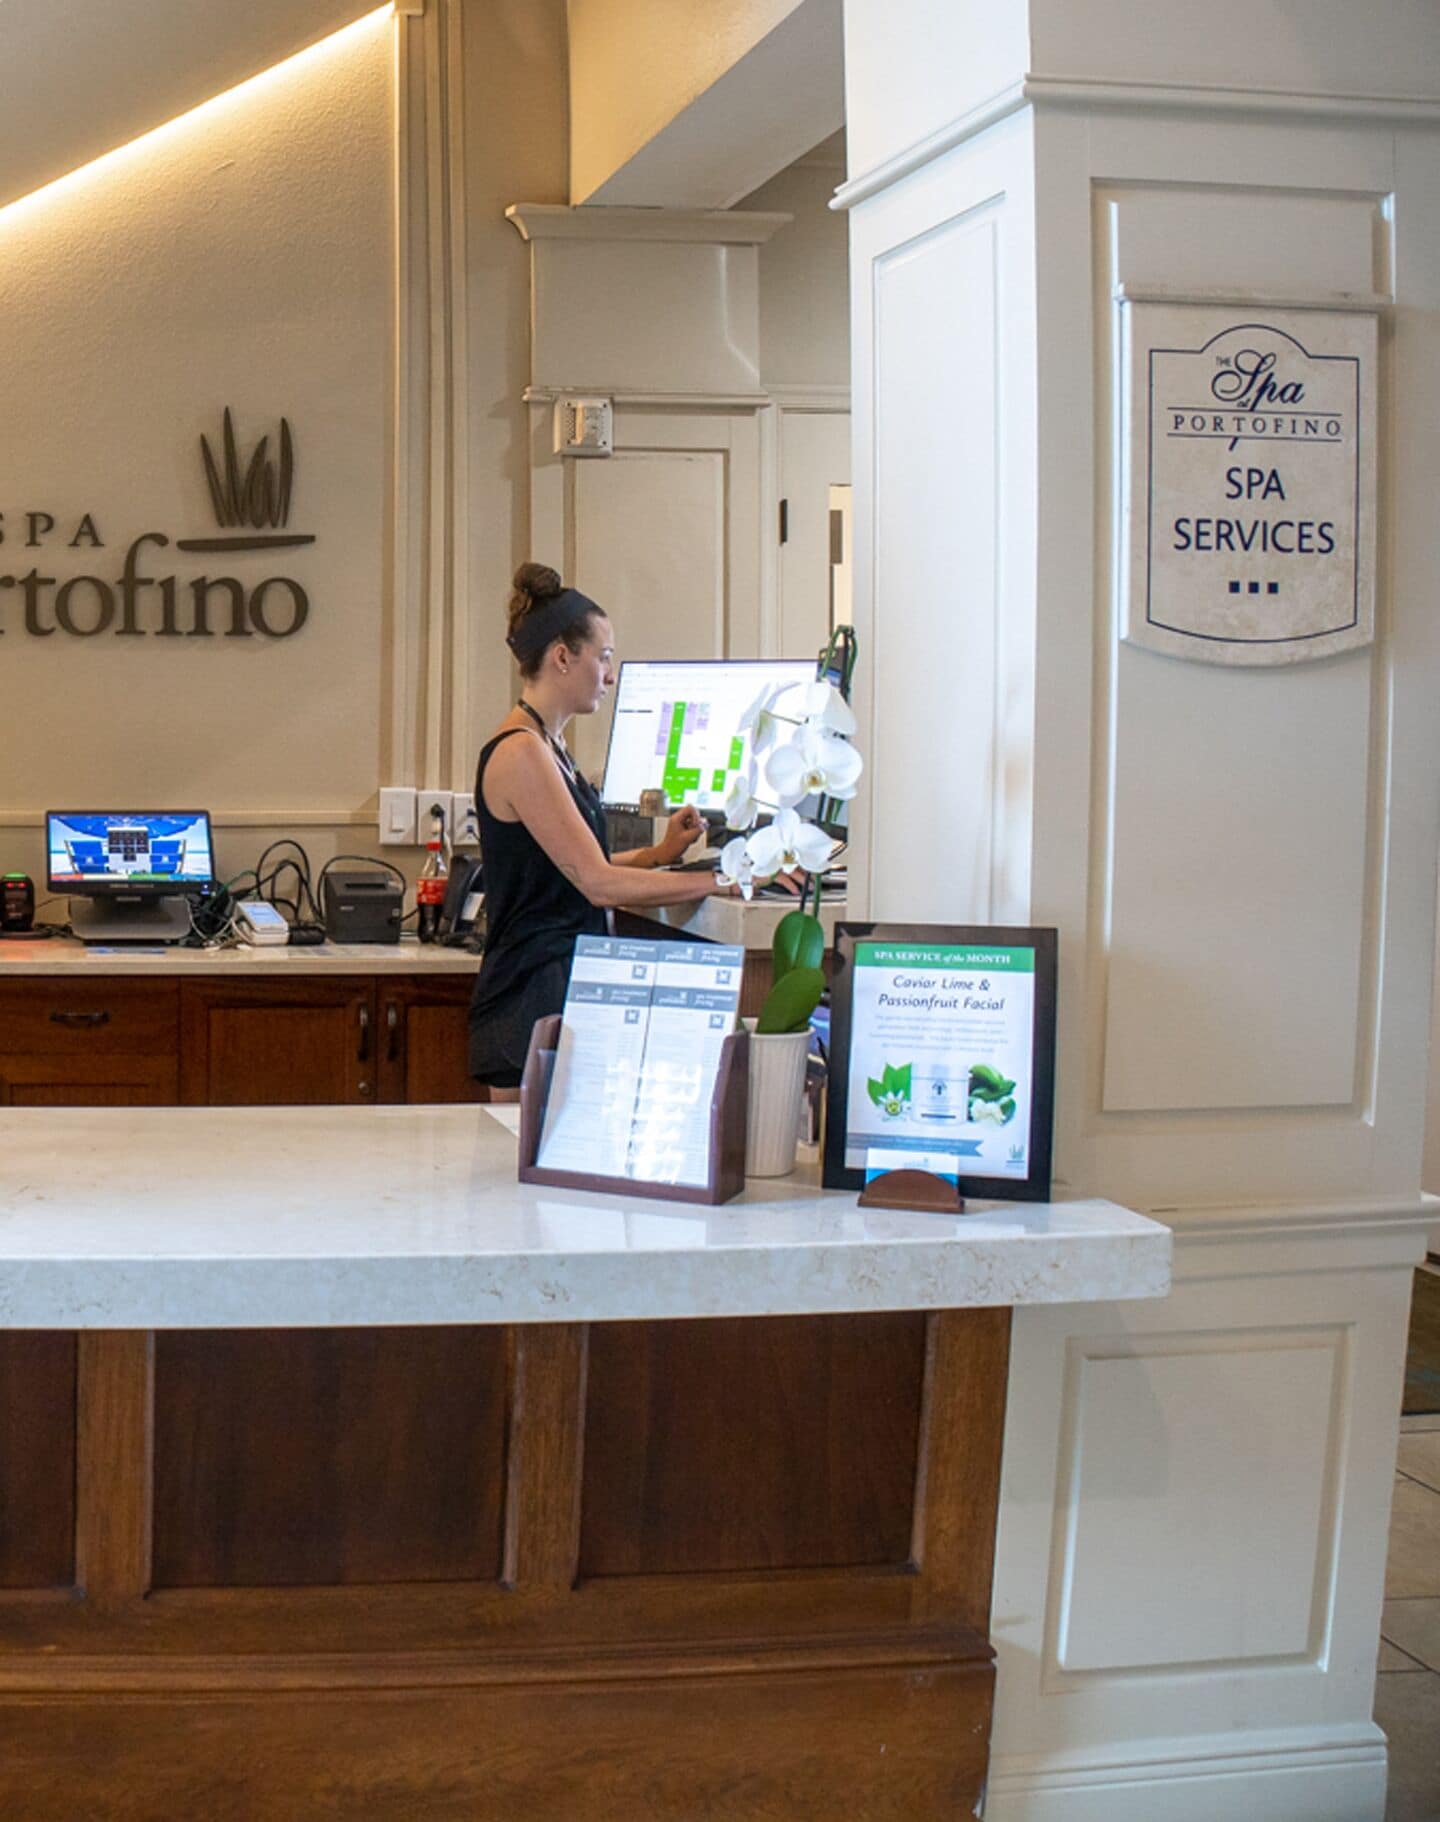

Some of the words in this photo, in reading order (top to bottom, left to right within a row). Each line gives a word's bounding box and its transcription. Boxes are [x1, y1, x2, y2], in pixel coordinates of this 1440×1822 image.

[1211, 349, 1305, 450] Spa
[1174, 414, 1341, 436] PORTOFINO
[1225, 466, 1286, 501] SPA
[1173, 517, 1336, 555] SERVICES
[874, 951, 893, 960] SPA
[895, 951, 940, 962] SERVICE
[966, 953, 1011, 964] MONTH
[893, 974, 936, 989] Caviar
[941, 977, 974, 991] Lime
[978, 978, 991, 992] &
[878, 993, 959, 1012] Passionfruit
[963, 997, 1006, 1011] Facial
